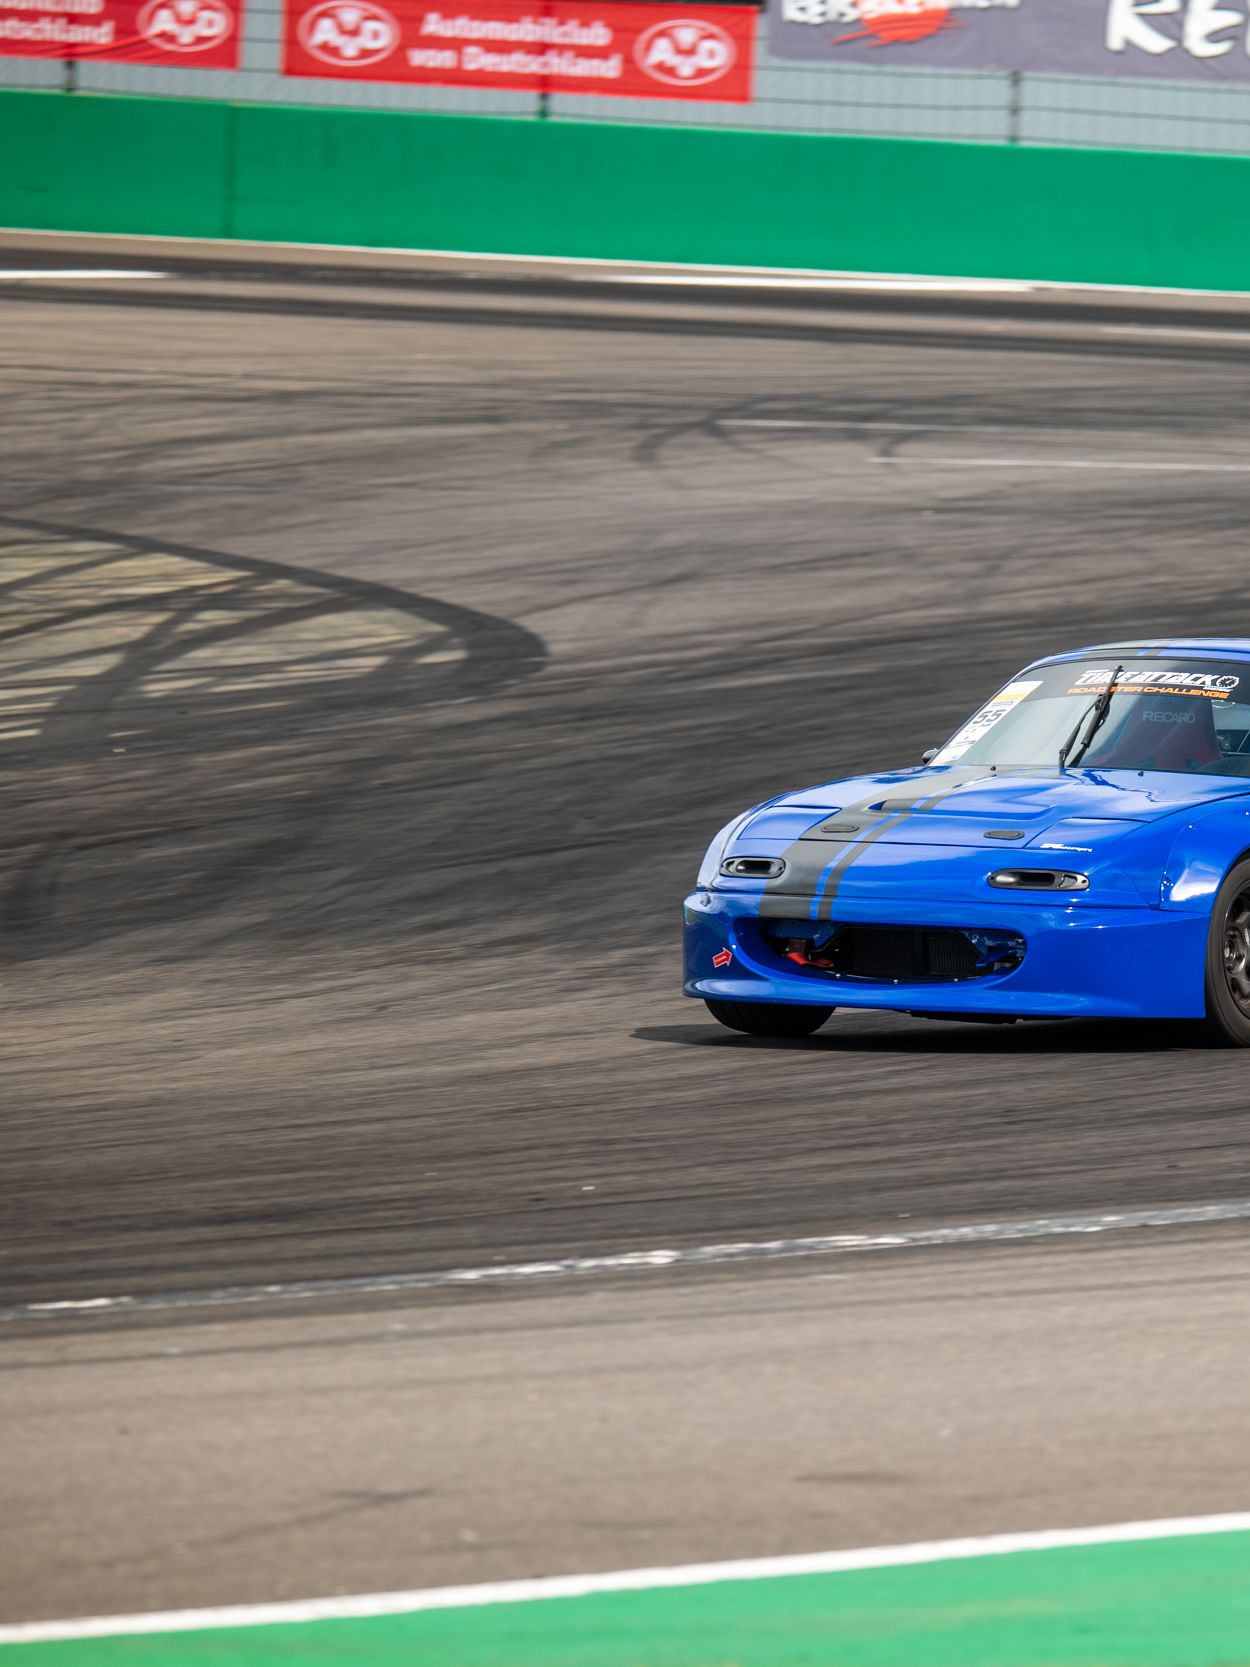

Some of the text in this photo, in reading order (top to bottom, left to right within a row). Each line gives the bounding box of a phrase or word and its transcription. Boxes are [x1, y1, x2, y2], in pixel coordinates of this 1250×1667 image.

[419, 12, 614, 46] Automobilclub
[406, 46, 623, 79] von Deutschland
[1143, 686, 1230, 699] CHALLENGE
[1142, 710, 1196, 724] RECARO
